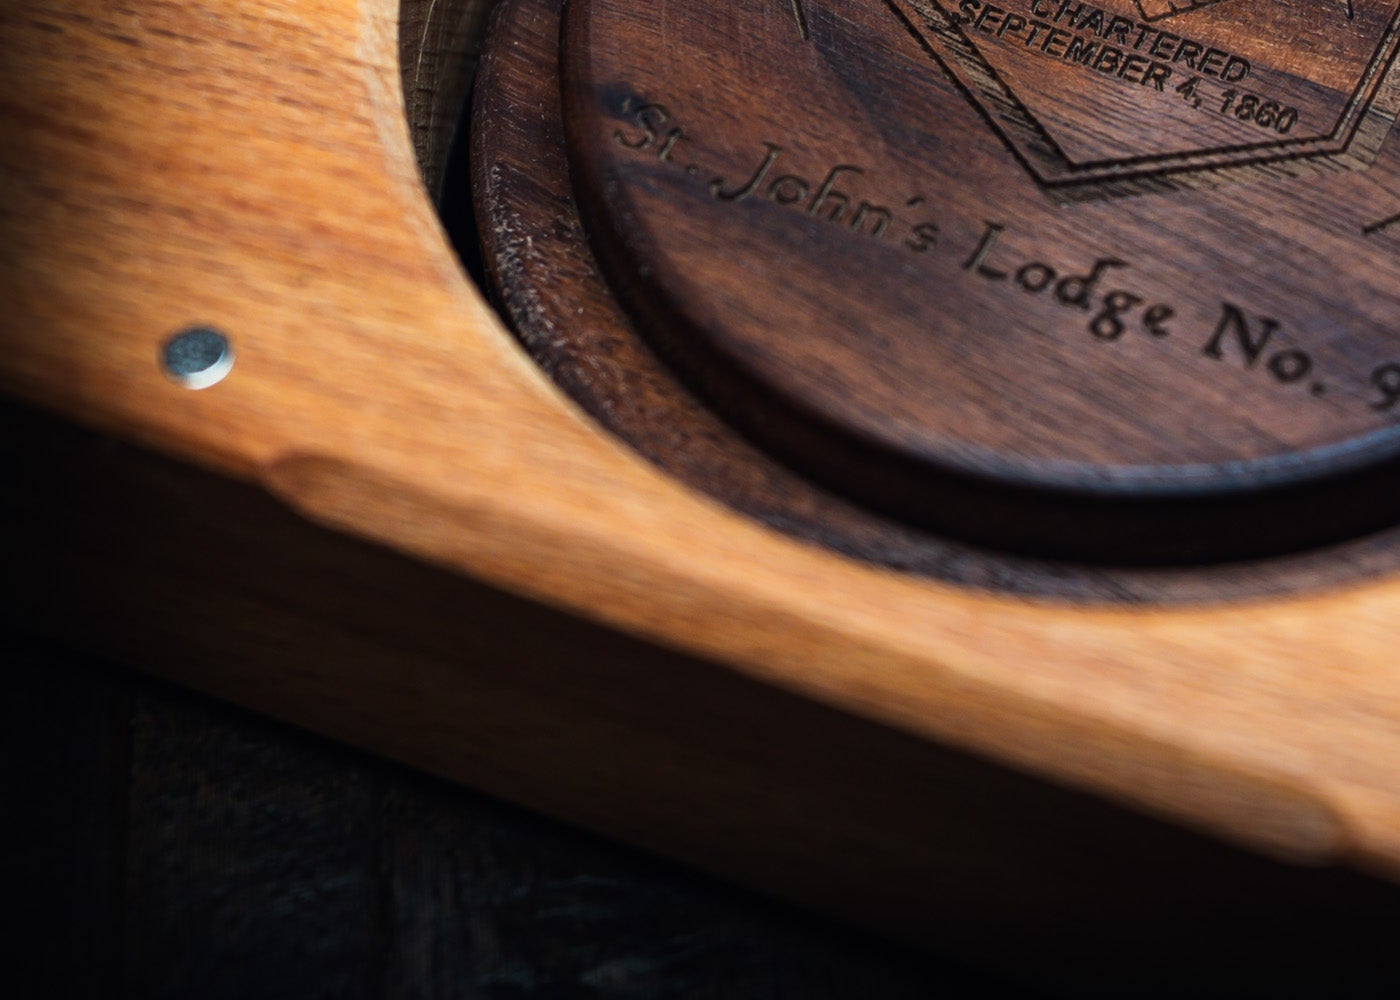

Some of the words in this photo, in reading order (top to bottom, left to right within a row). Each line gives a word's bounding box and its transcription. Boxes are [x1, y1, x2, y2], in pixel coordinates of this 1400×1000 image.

[1220, 87, 1301, 135] 1860
[613, 102, 700, 176] St.
[709, 141, 941, 253] John's
[962, 218, 1178, 342] Lodge
[1201, 301, 1328, 397] No.
